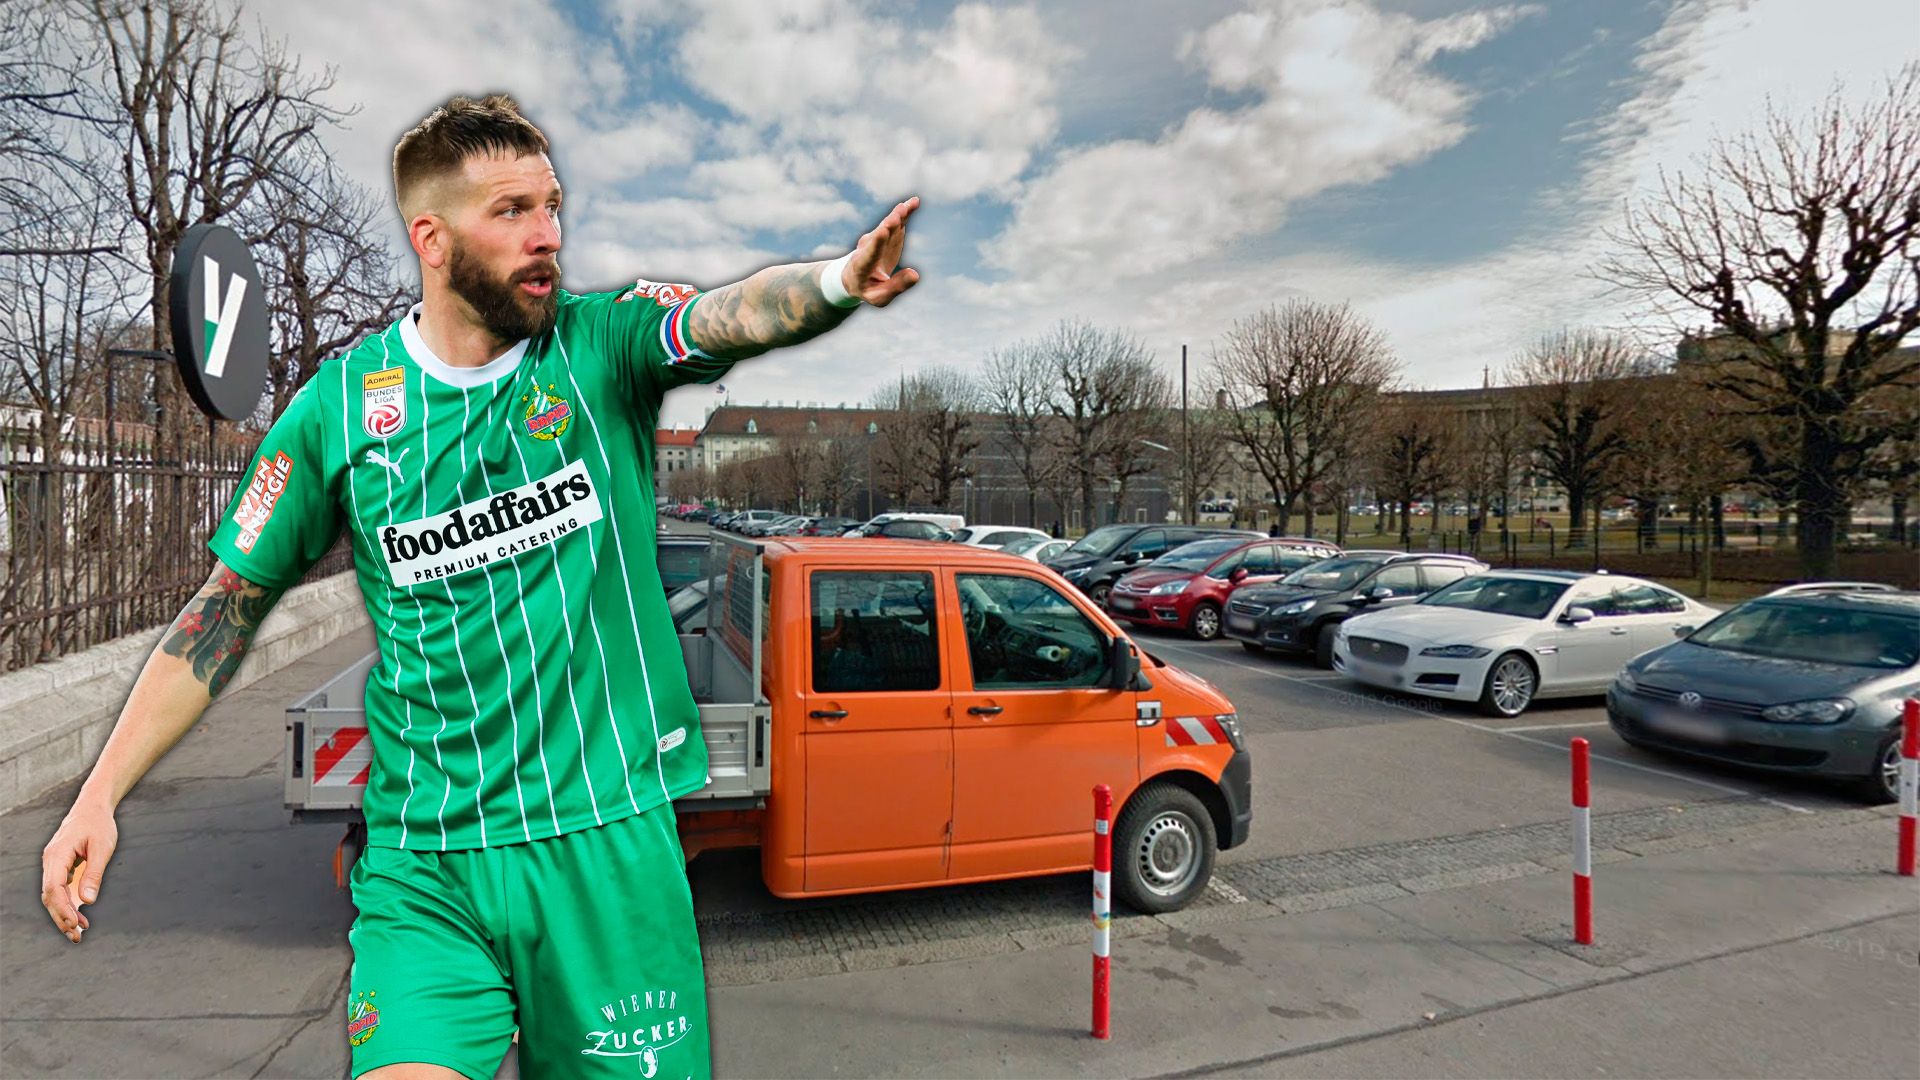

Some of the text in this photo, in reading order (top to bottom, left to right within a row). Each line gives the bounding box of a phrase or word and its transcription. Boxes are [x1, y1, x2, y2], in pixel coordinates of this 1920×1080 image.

[366, 373, 402, 385] ADMIRAL
[366, 386, 403, 398] BUNDES
[374, 395, 395, 404] LIGA
[527, 403, 569, 431] RAPID
[237, 460, 271, 518] WIEN
[238, 455, 291, 550] ENERGIE
[382, 473, 591, 563] foodaffairs
[413, 518, 578, 582] PREMIUM CATERING
[601, 990, 677, 1023] WIENER
[581, 1016, 692, 1056] ZUCKER
